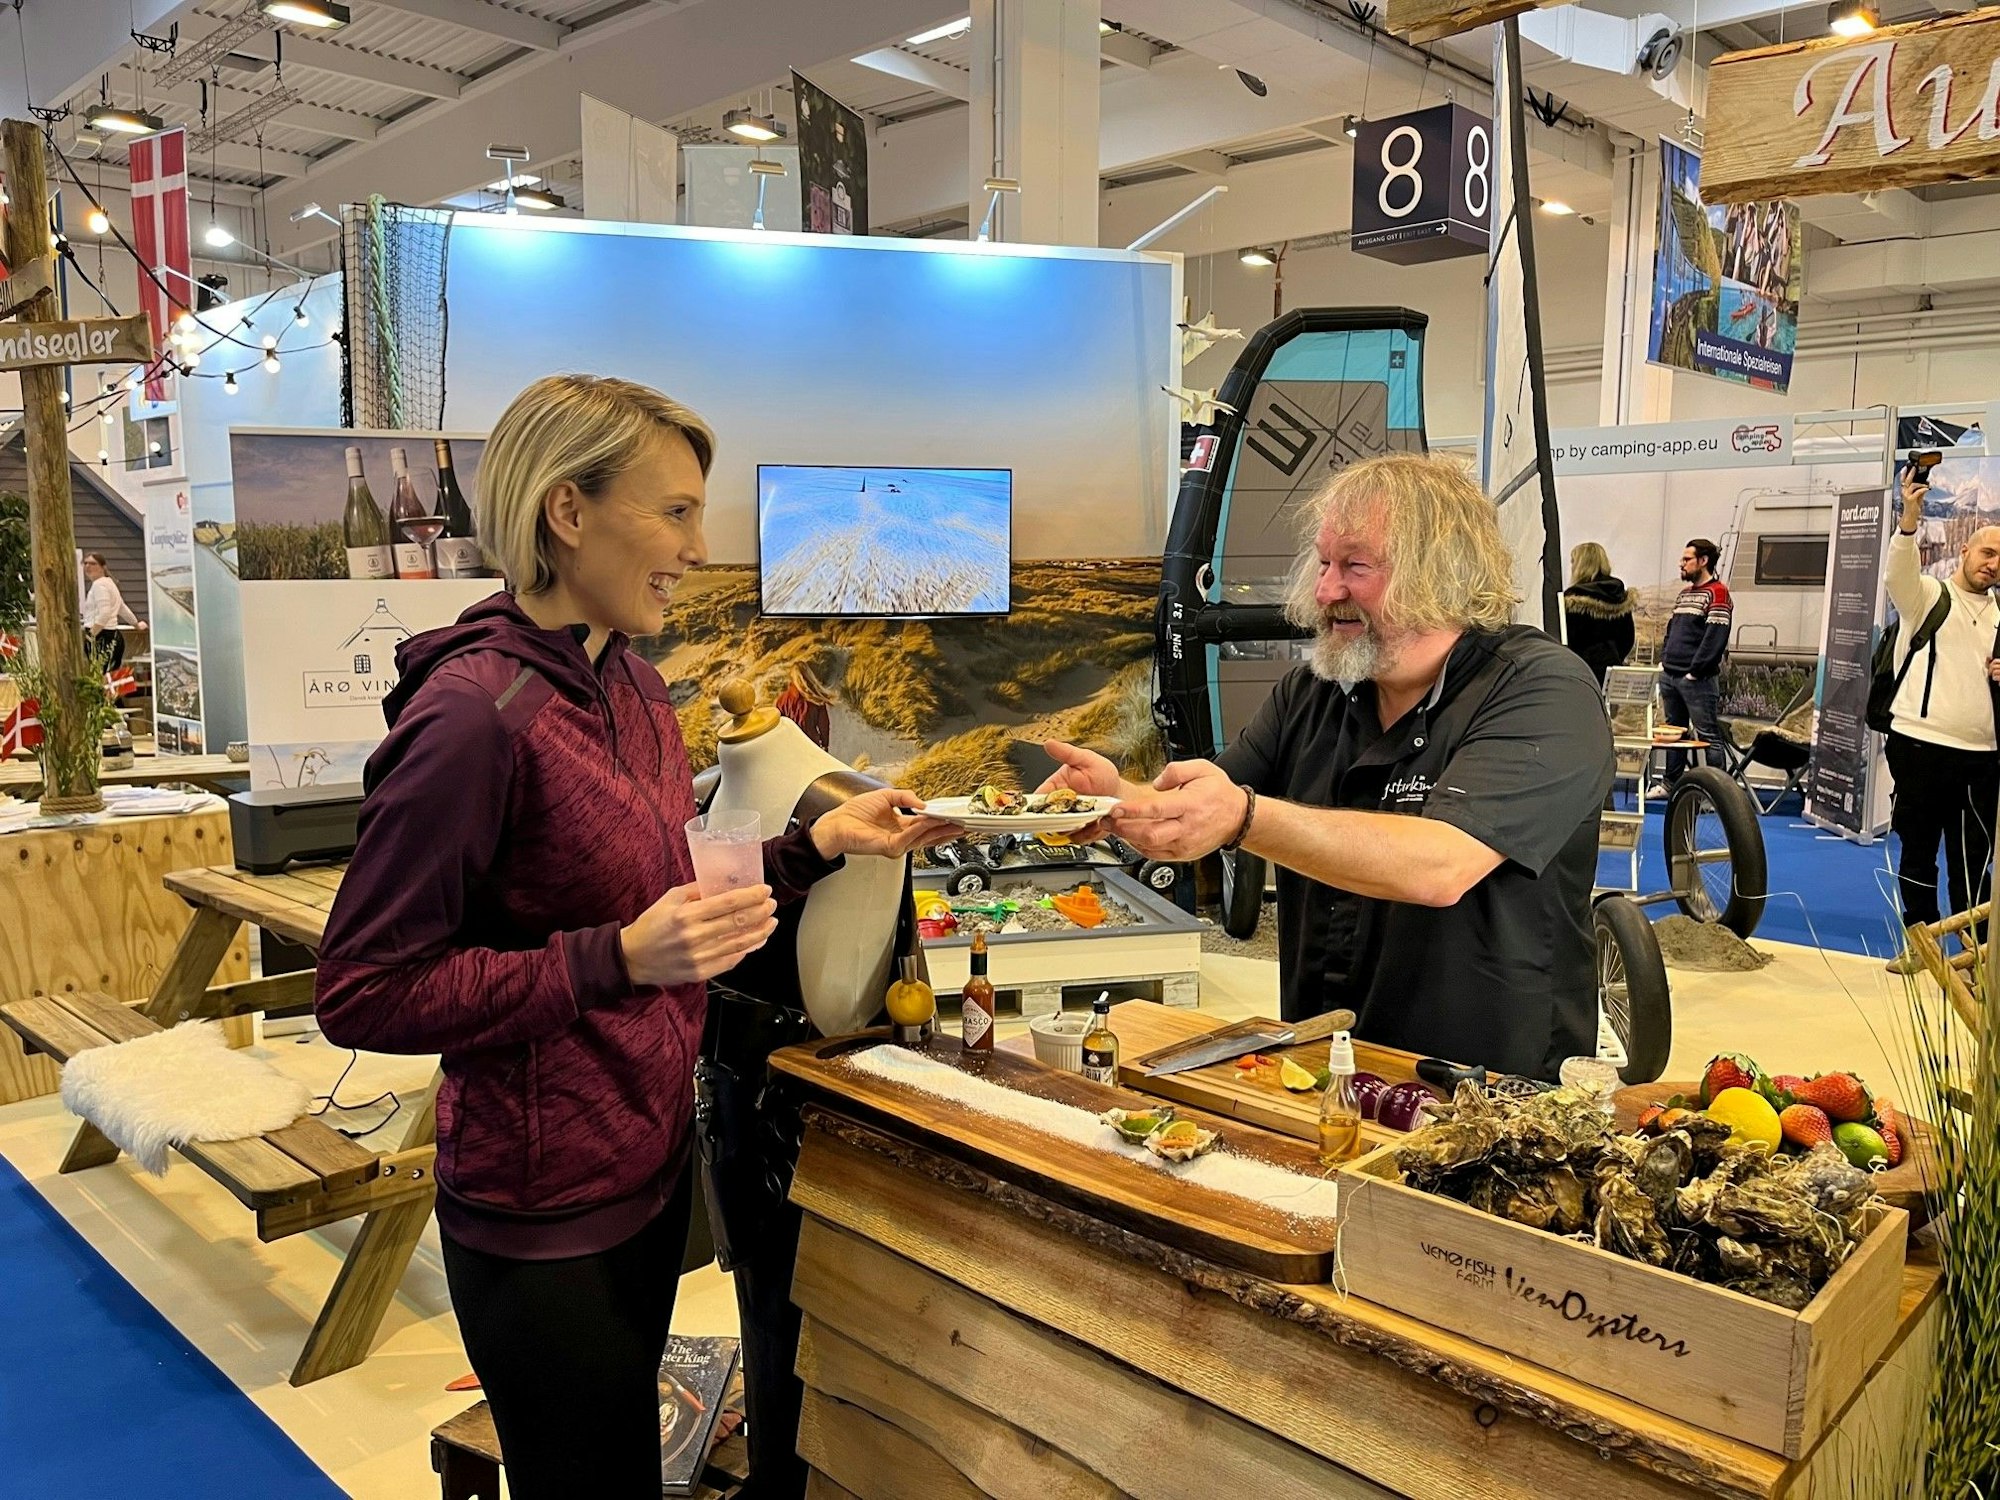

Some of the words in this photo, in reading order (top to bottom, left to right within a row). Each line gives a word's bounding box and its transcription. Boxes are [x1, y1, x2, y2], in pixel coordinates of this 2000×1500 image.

[1378, 125, 1423, 218] 8
[1464, 125, 1490, 218] 8
[1357, 236, 1386, 246] AUSGANG
[1386, 233, 1398, 241] OST
[1697, 338, 1742, 366] Internationale
[1743, 350, 1783, 376] Spezialreisen
[1569, 444, 1587, 461] by
[1591, 438, 1719, 458] camping-app.eu
[1840, 504, 1880, 523] nord.camp
[1172, 602, 1184, 619] 3.1
[1172, 633, 1183, 660] SPIN
[309, 679, 350, 693] ÅRØ
[361, 680, 395, 691] VIN
[1465, 1258, 1497, 1278] FISH
[1456, 1269, 1494, 1293] FARM
[671, 1344, 693, 1354] The
[684, 1354, 712, 1365] King
